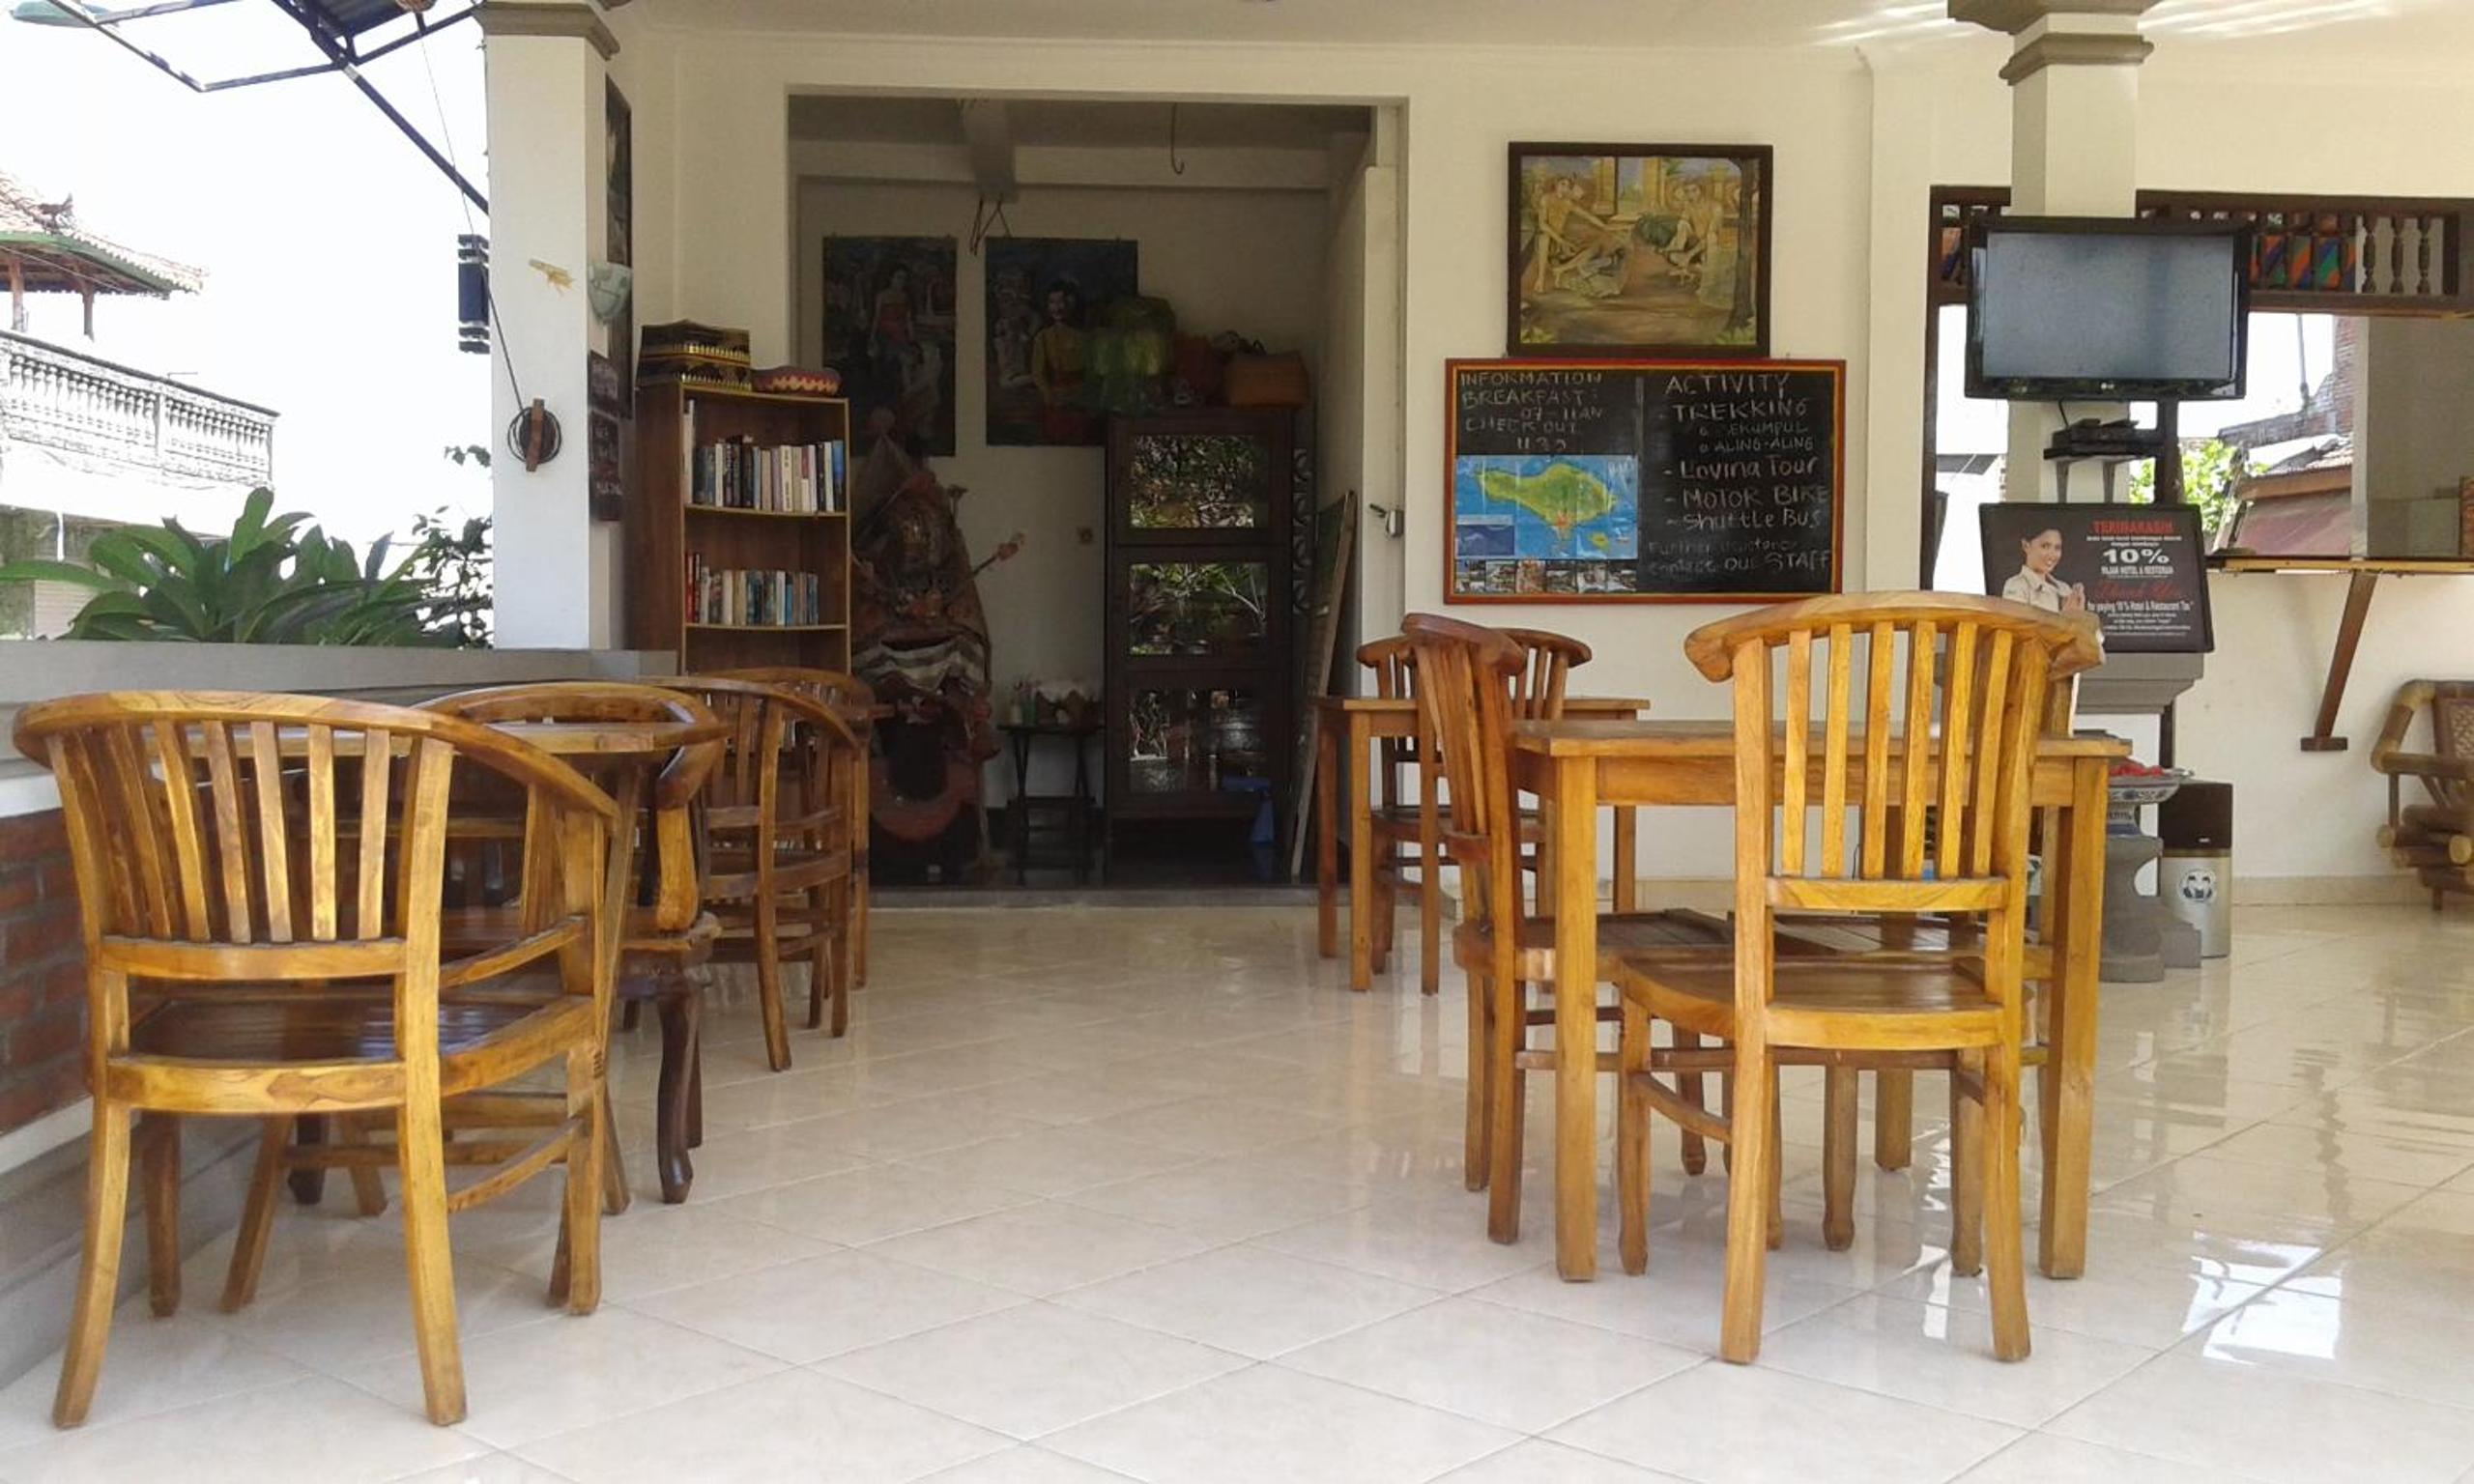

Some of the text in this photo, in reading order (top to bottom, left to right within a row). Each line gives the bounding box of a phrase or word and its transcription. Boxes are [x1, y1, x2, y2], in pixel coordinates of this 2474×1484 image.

[1460, 371, 1602, 386] INFORMATION
[1665, 373, 1790, 398] ACTIVITY
[1672, 398, 1809, 421] TREKKING
[1680, 454, 1819, 479] Lovina Tour
[1683, 485, 1828, 508] MOTOR BIKE
[2103, 549, 2170, 564] 10%
